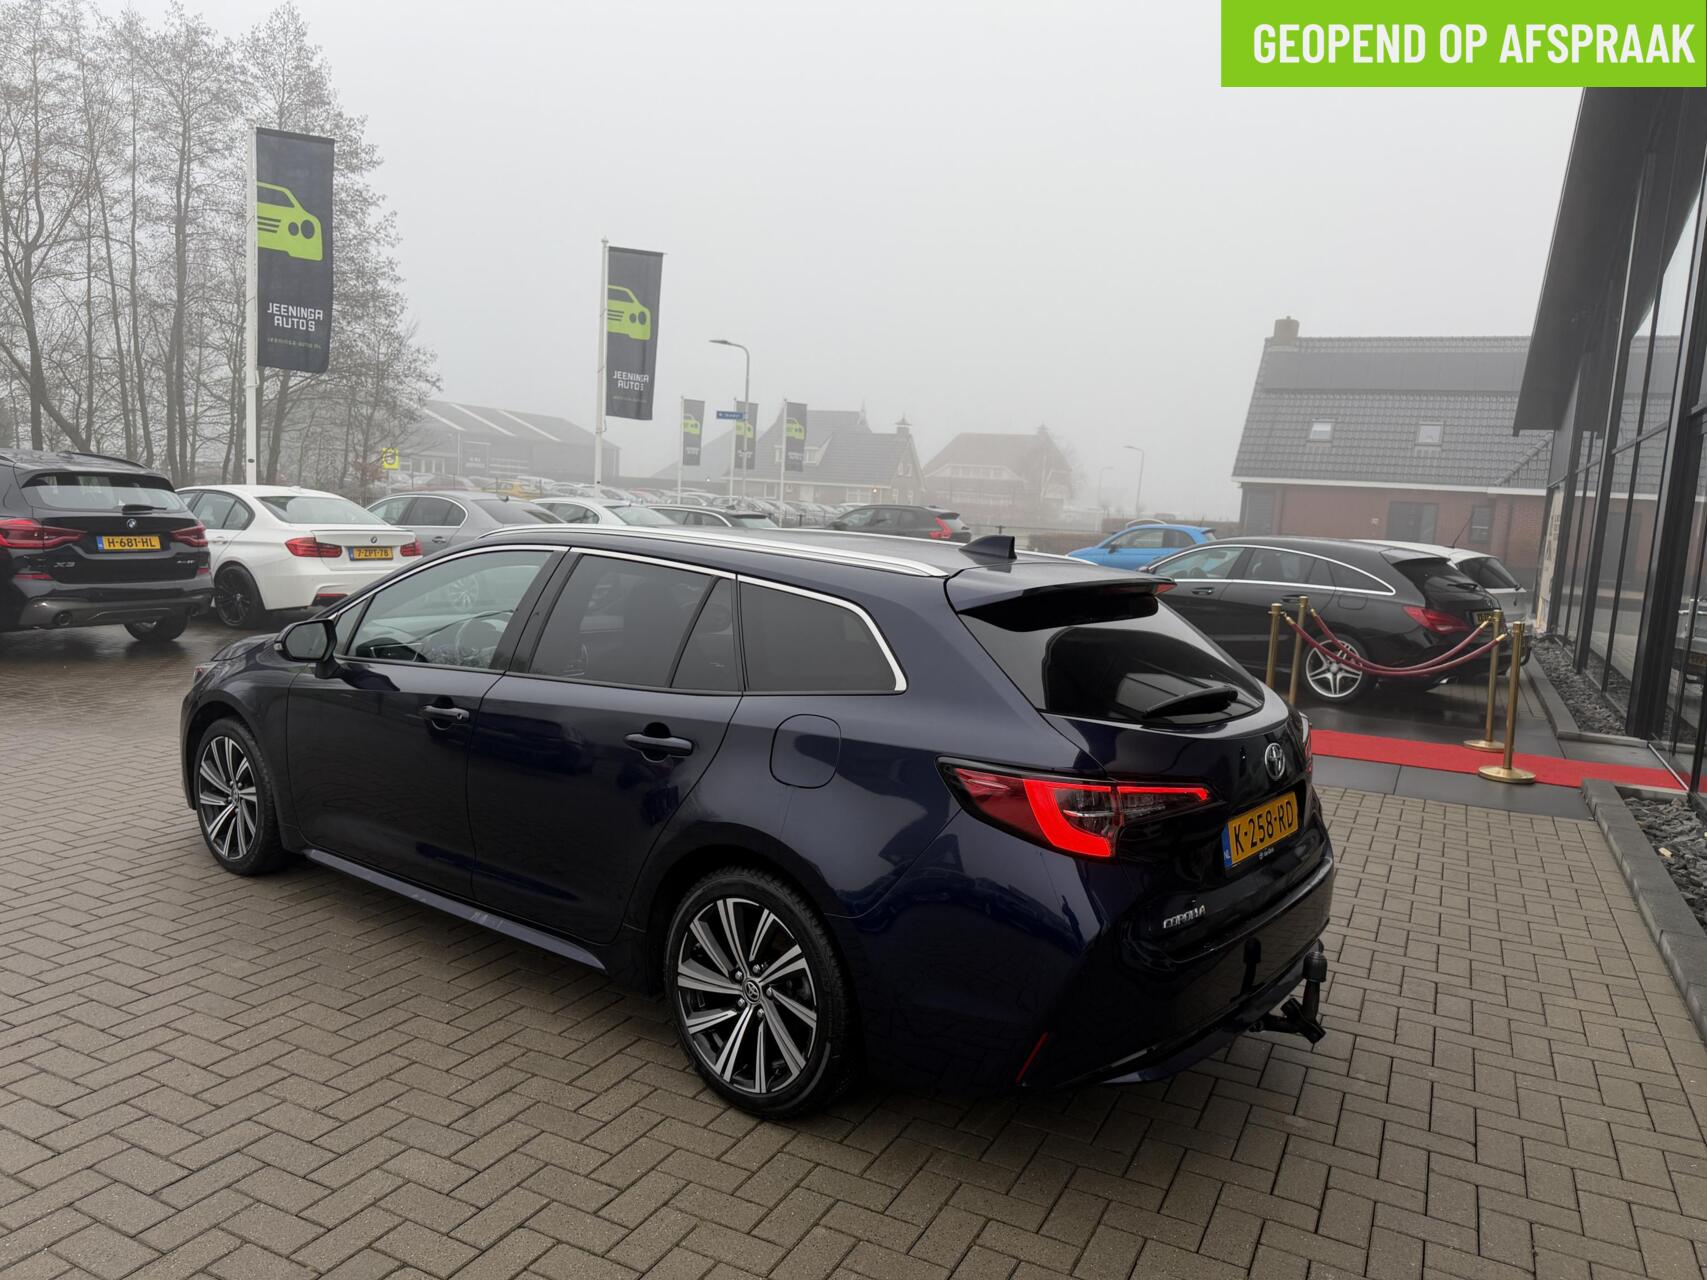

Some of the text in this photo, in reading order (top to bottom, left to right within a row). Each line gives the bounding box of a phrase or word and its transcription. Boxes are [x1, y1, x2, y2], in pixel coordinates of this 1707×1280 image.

[266, 302, 324, 321] JEENINGA
[106, 537, 157, 549] H-681-HL
[1233, 800, 1294, 857] K-258-RD
